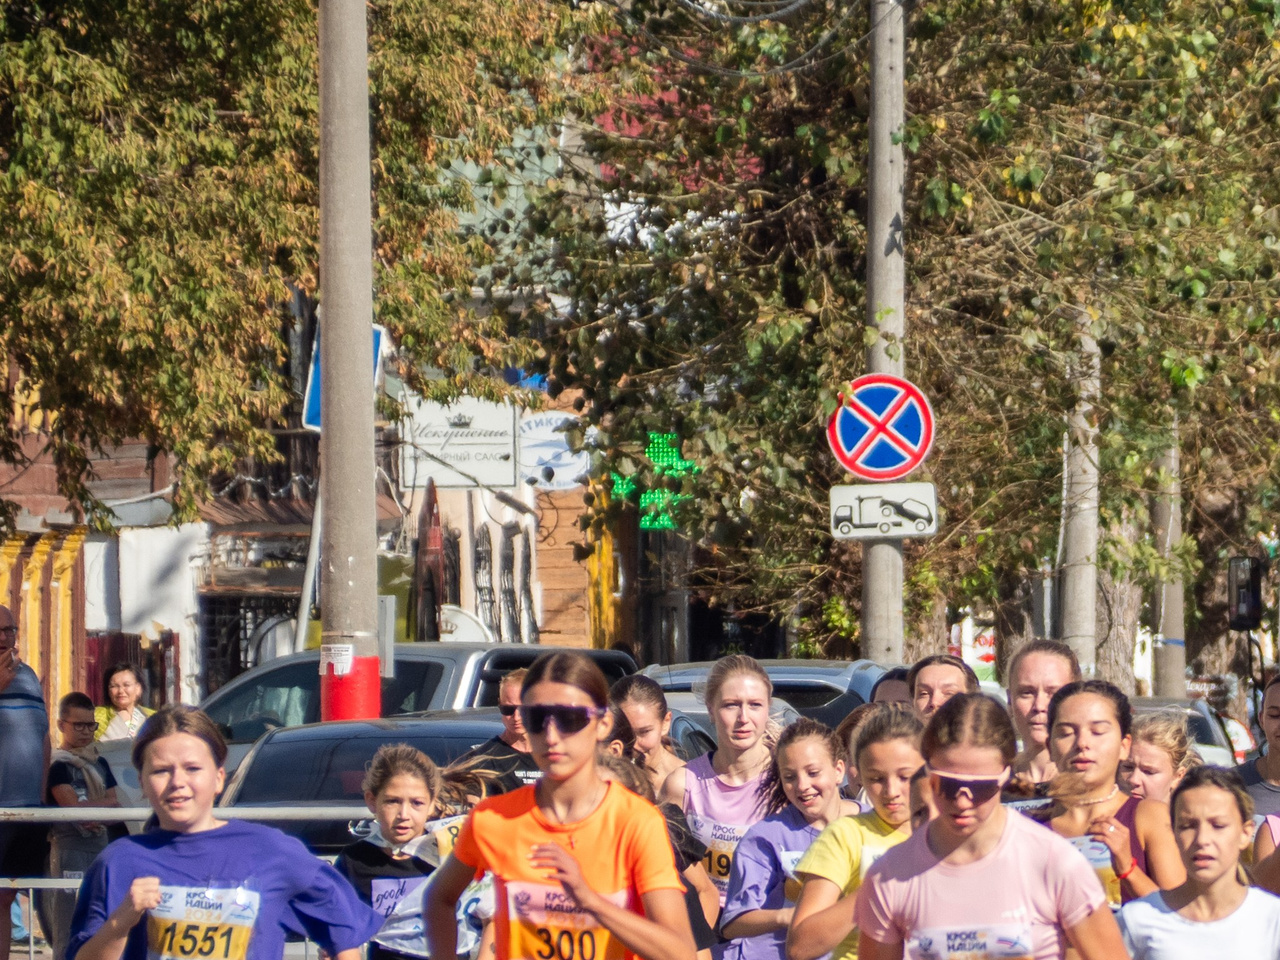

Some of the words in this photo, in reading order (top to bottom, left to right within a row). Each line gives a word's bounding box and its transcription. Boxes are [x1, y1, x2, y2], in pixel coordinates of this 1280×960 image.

[413, 422, 509, 451] Искушение
[474, 451, 509, 462] САЛО
[713, 823, 737, 834] КРОСС
[710, 831, 741, 842] НАЦИИ
[711, 840, 733, 850] 202
[704, 850, 731, 877] 19
[186, 891, 211, 900] КРО
[376, 880, 407, 909] good
[185, 899, 223, 910] НАЦИИ
[164, 922, 234, 958] 1551
[947, 931, 977, 941] КРОСС
